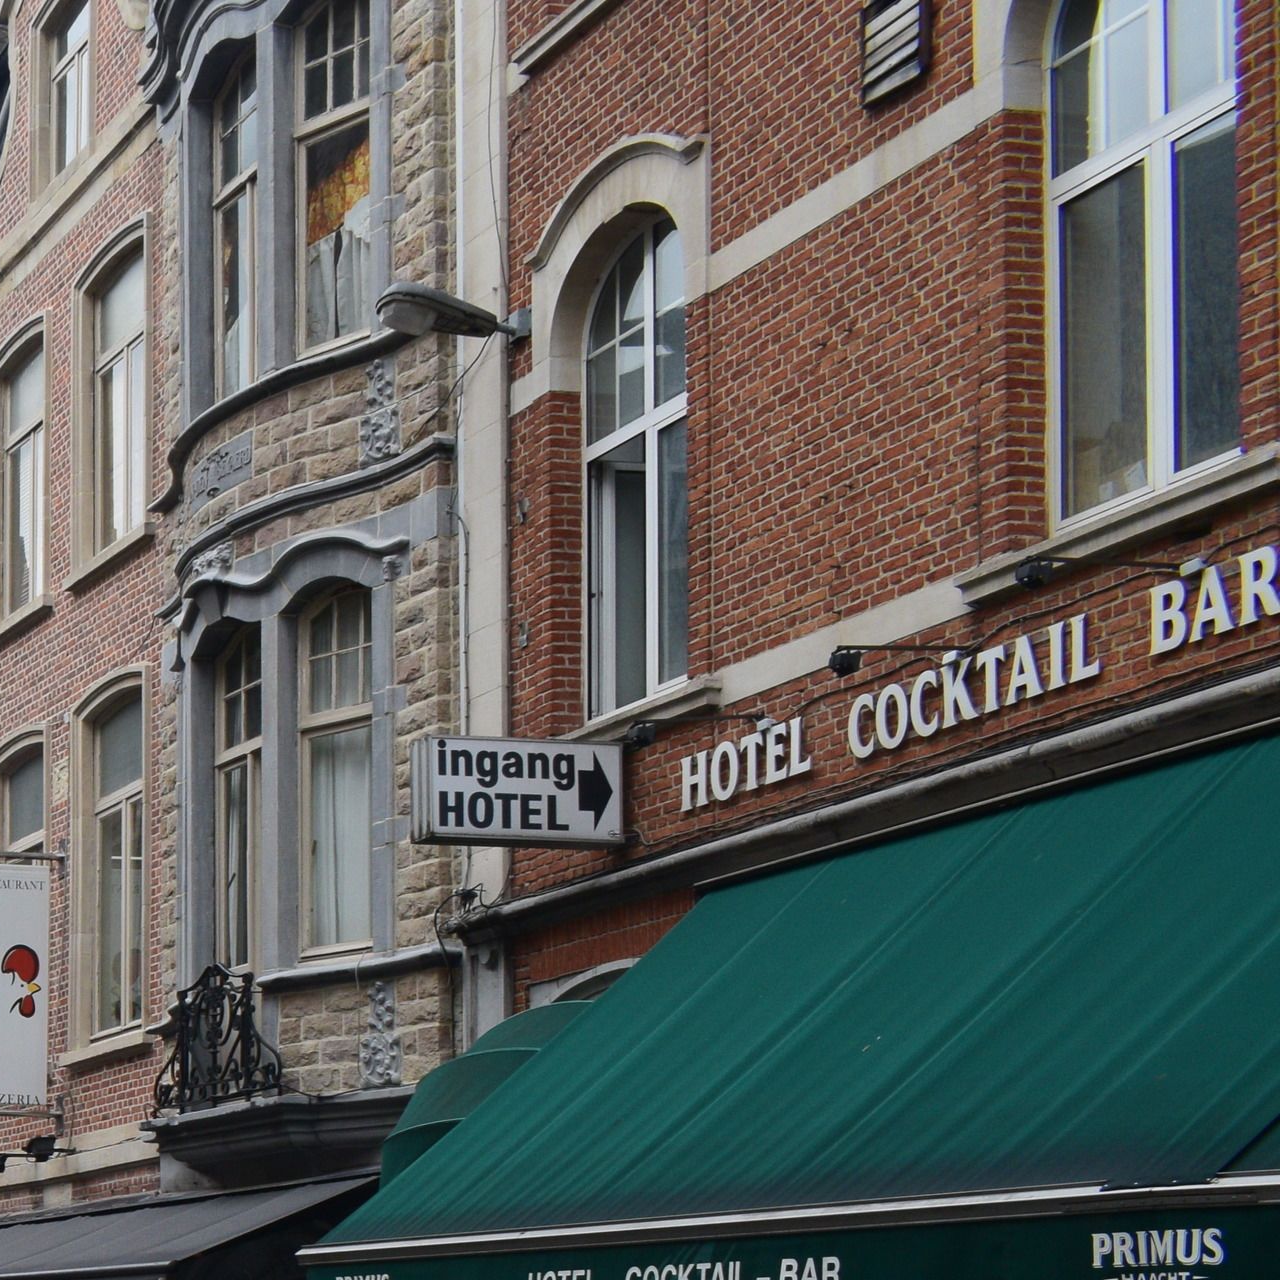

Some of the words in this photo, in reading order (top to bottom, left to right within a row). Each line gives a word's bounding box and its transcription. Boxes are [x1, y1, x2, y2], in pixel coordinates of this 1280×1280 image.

[680, 716, 811, 812] HOTEL
[848, 613, 1101, 759] COCKTAIL
[1149, 545, 1280, 656] BAR
[438, 739, 576, 791] ingang
[439, 791, 570, 831] HOTEL
[1091, 1228, 1225, 1268] PRIMUS
